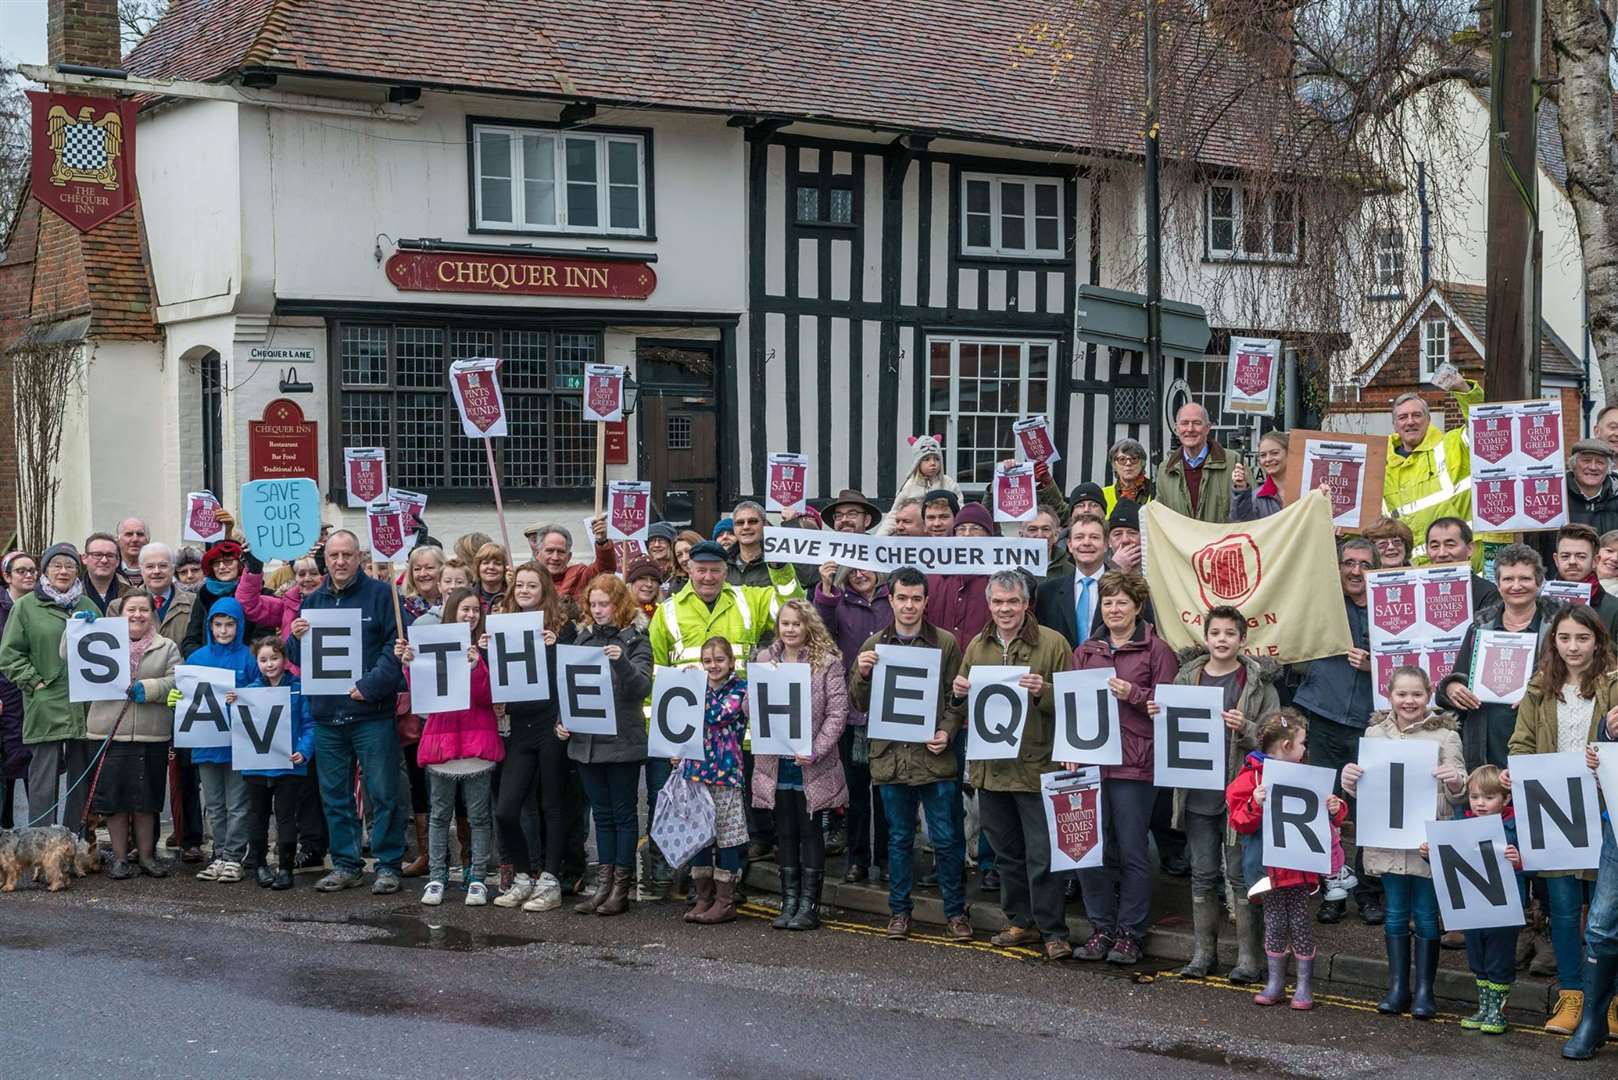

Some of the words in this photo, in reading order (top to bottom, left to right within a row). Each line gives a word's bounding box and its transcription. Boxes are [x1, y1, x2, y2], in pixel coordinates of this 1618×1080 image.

[74, 186, 95, 196] THE
[60, 194, 110, 205] CHEQUER
[75, 204, 95, 214] INN
[438, 260, 558, 289] CHEQUER
[565, 266, 609, 288] INN
[251, 348, 288, 358] CHEQUER
[289, 350, 312, 359] LANE
[464, 387, 490, 398] PINTS
[469, 397, 488, 406] NOT
[466, 406, 499, 416] POUNDS
[255, 425, 294, 433] CHEQUER
[296, 425, 311, 433] INN
[1475, 430, 1509, 438] COMMUNITY
[1528, 427, 1551, 435] GRUB
[1478, 437, 1508, 445] COMES
[1530, 434, 1549, 442] NOT
[1525, 441, 1555, 449] GREED
[772, 480, 802, 492] SAVE
[1320, 476, 1348, 486] GRUB
[256, 482, 300, 503] SAVE
[1330, 486, 1345, 495] OT
[1484, 492, 1508, 500] PINTS
[1331, 496, 1350, 504] EED
[1525, 494, 1560, 507] SAVE
[264, 503, 301, 521] OUR
[614, 509, 644, 520] SAVE
[1480, 505, 1514, 514] POUNDS
[257, 523, 305, 547] PUB
[765, 537, 822, 557] SAVE
[829, 542, 869, 561] THE
[875, 546, 985, 568] CHEQUER
[993, 548, 1040, 566] INN
[1425, 594, 1465, 603] COMMUNITY
[1375, 603, 1414, 617] SAVE
[1429, 602, 1463, 611] COMES
[1433, 610, 1460, 618] FIRST
[77, 632, 121, 683] S
[311, 627, 352, 679] E
[494, 630, 538, 686] H
[419, 642, 461, 696] T
[1493, 661, 1517, 669] SAVE
[1493, 668, 1514, 677] OUR
[1494, 675, 1512, 683] PUB
[566, 665, 607, 718] E
[881, 665, 928, 725] E
[178, 682, 230, 732] A
[758, 683, 802, 740] H
[657, 686, 698, 743] C
[973, 684, 1022, 747] Q
[1064, 689, 1108, 750] U
[238, 704, 284, 754] V
[1166, 707, 1214, 771] E
[1390, 762, 1404, 829] I
[1057, 809, 1095, 823] COMMUNITY
[1271, 783, 1326, 854] R
[1523, 777, 1589, 850] N
[1061, 820, 1093, 833] COMES
[1066, 831, 1090, 844] FIRST
[1438, 840, 1508, 910] N
